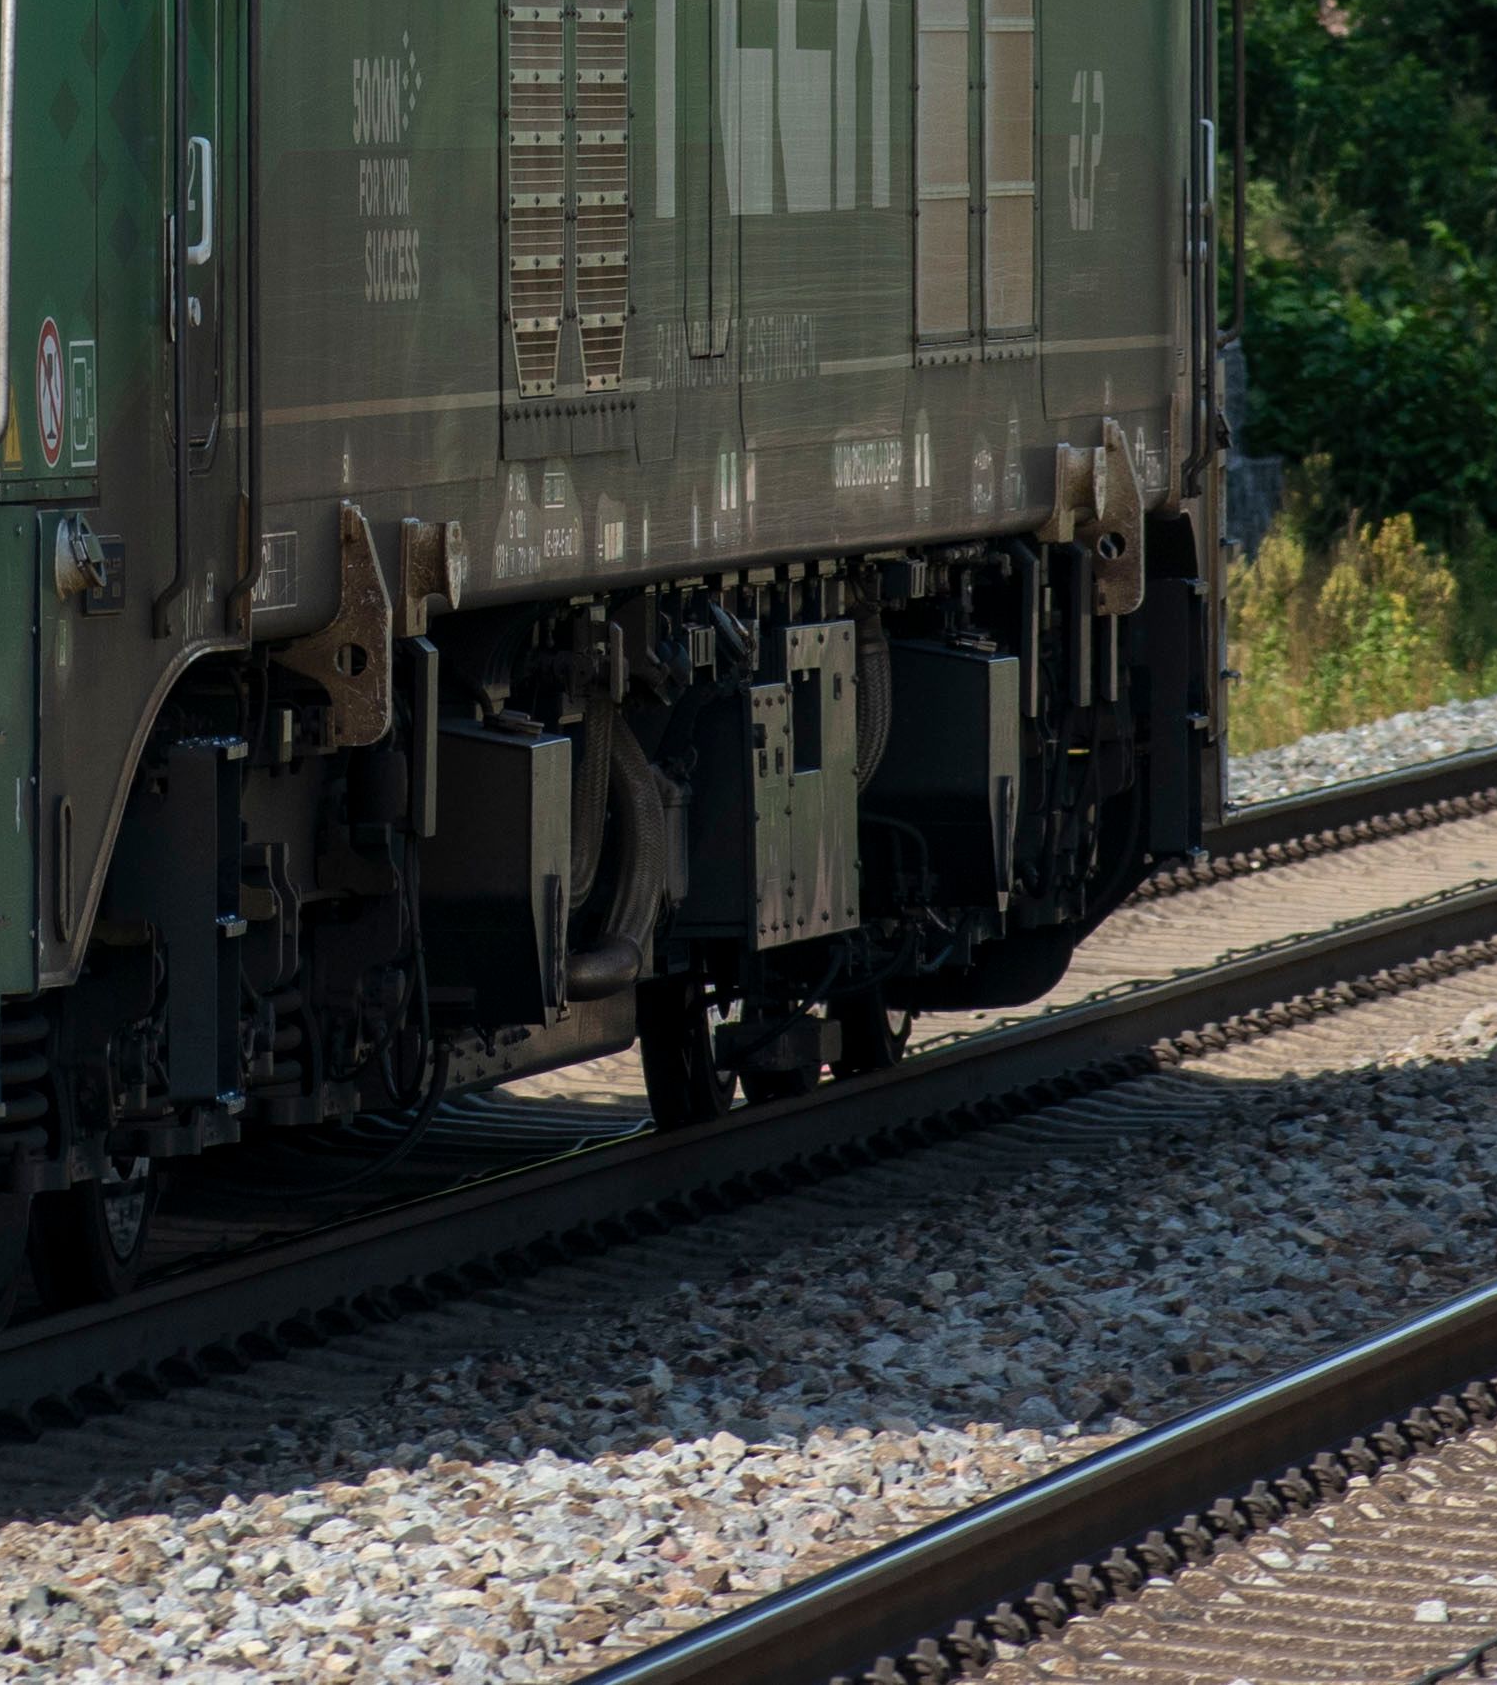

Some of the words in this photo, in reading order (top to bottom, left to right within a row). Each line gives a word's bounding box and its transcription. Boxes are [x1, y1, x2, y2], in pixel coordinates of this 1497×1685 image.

[352, 56, 400, 144] 500kN
[359, 159, 380, 217] FOR
[381, 159, 409, 217] YOUR
[365, 229, 420, 302] SUCCESS
